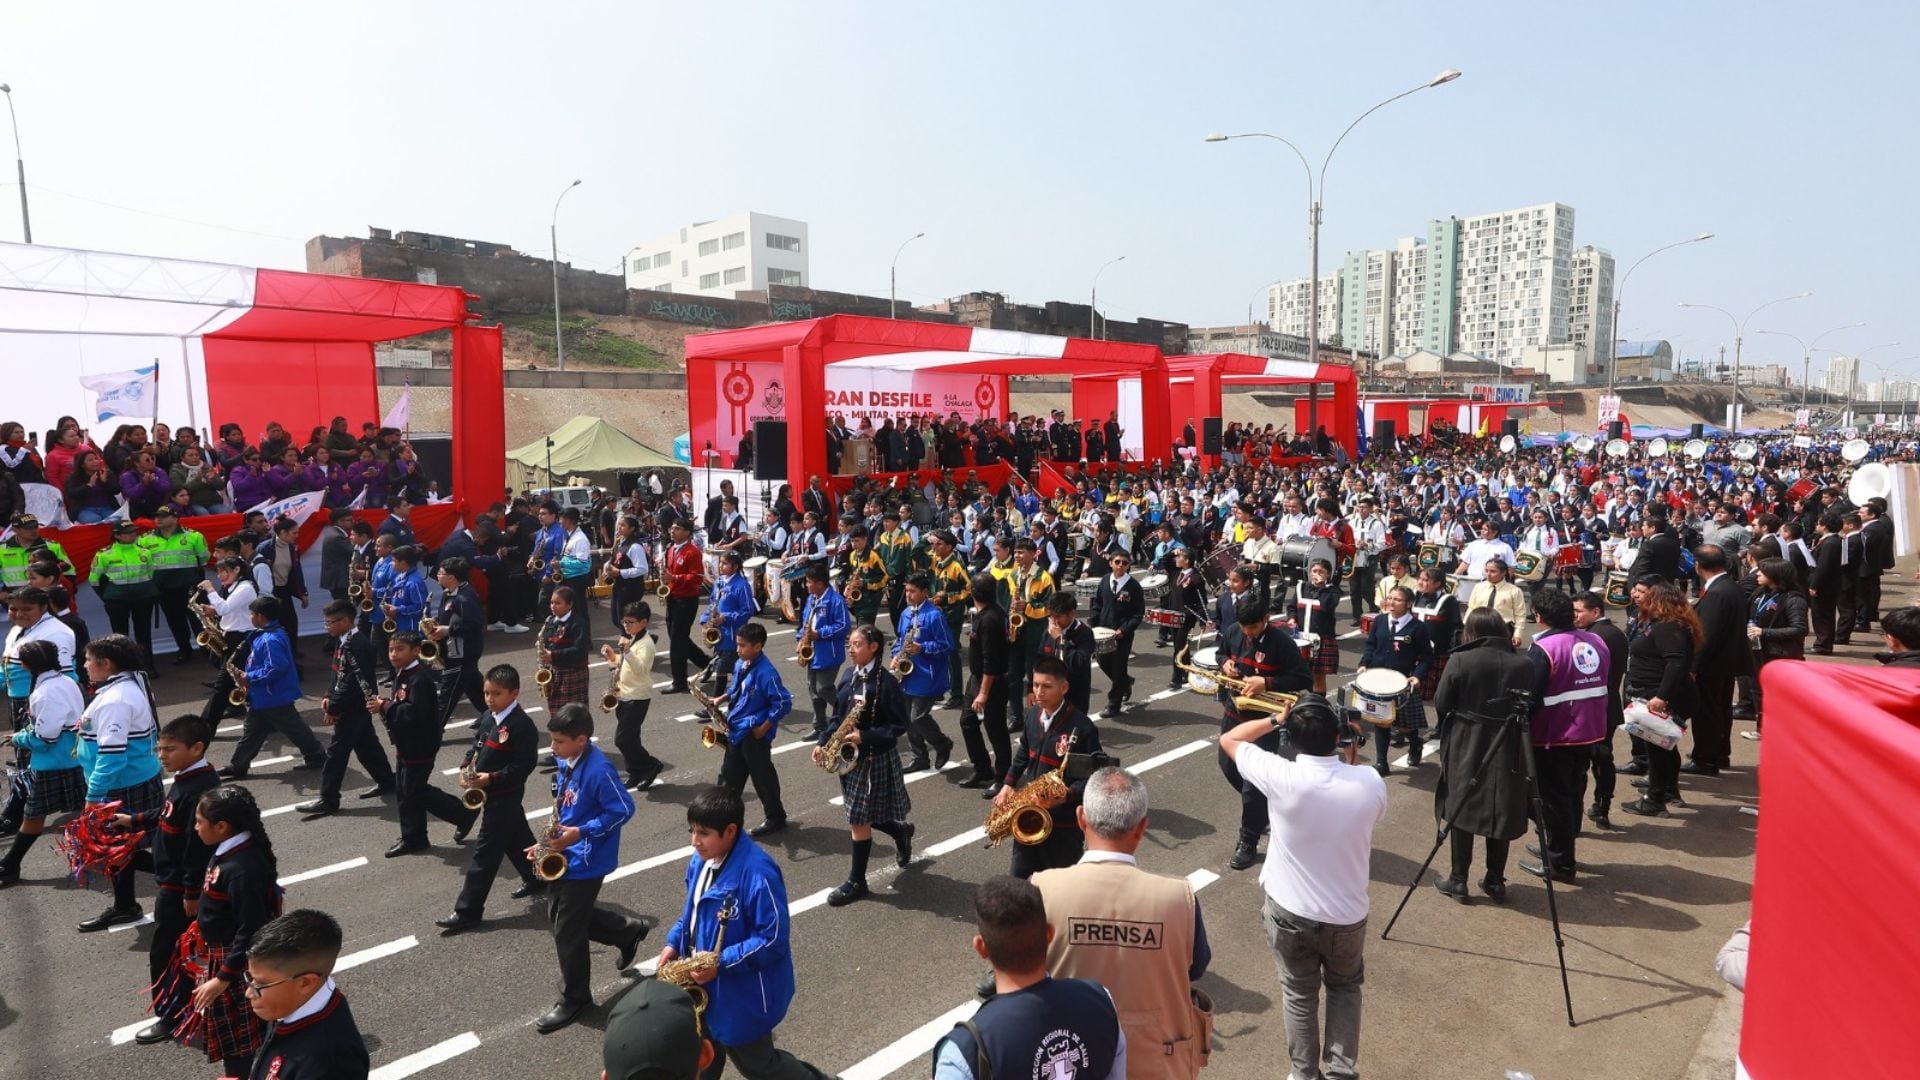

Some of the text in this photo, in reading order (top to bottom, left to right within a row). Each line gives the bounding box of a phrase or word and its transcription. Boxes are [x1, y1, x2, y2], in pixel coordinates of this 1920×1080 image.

[824, 390, 932, 407] RAN DESFILE
[824, 410, 842, 419] ICO
[852, 410, 888, 419] MILITAR
[1073, 923, 1156, 945] PRENSA
[1032, 1029, 1089, 1080] ECCION REGIONAL DE SALUD
